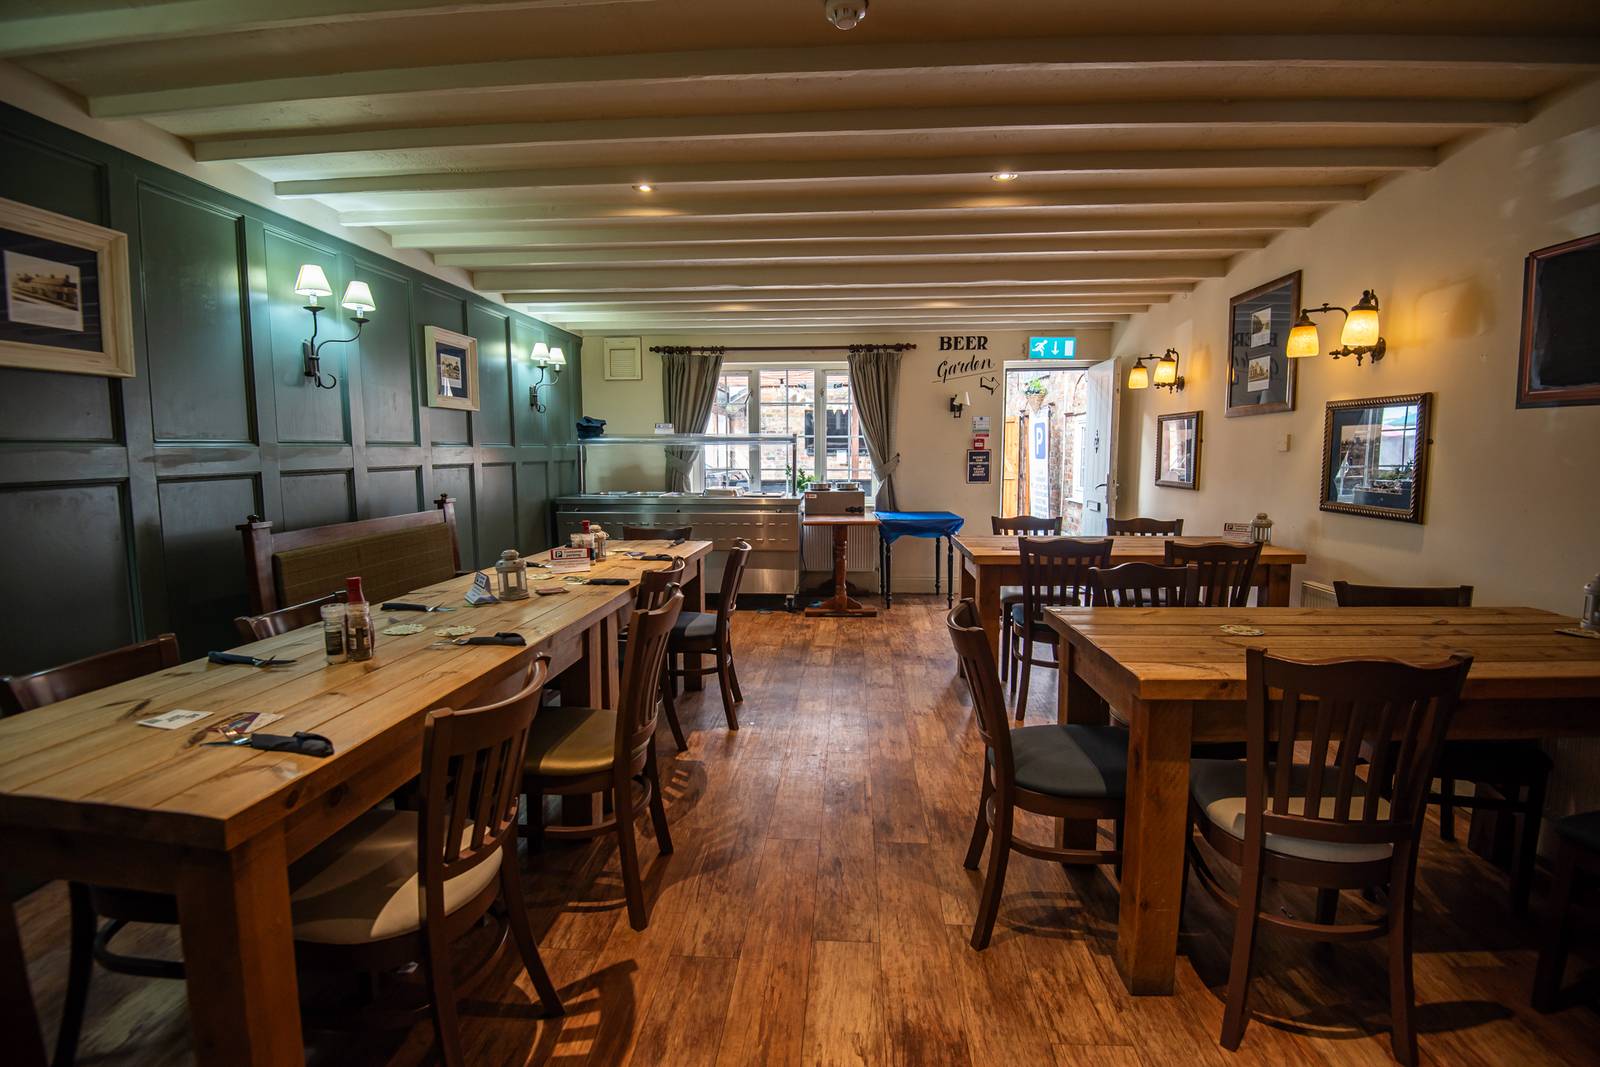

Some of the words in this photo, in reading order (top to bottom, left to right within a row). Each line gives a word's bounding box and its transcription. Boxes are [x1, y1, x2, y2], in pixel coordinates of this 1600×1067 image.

[938, 335, 989, 351] BEER
[937, 354, 991, 384] Garden
[1035, 427, 1044, 457] P
